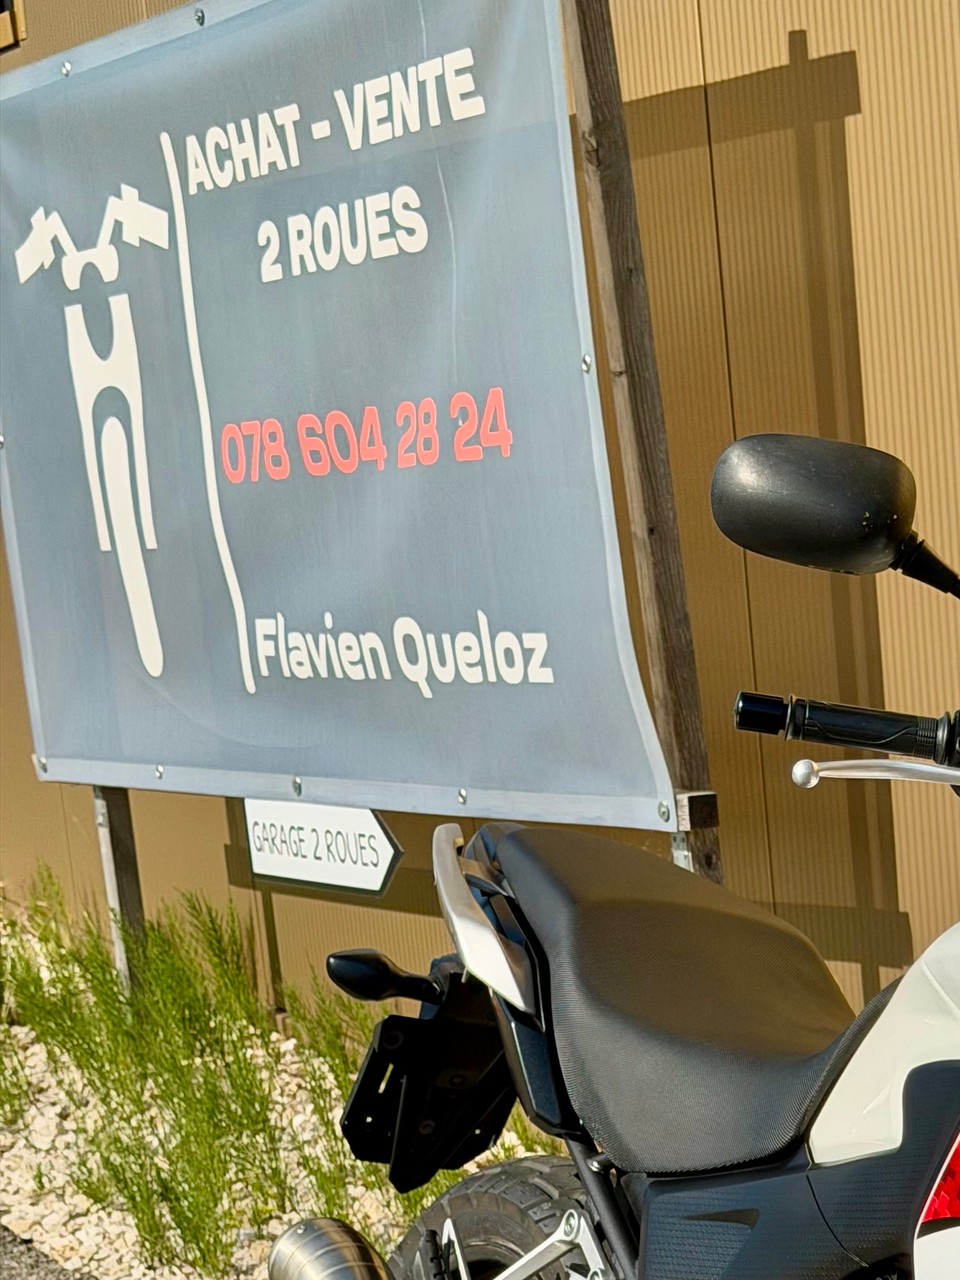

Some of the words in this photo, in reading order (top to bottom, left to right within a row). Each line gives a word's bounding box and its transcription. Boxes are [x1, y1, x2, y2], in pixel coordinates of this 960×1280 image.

[186, 103, 300, 195] ACHAT
[311, 119, 331, 140] -
[333, 47, 485, 150] VENTE
[257, 220, 283, 283] 2
[287, 185, 429, 277] ROUES
[221, 418, 290, 484] 078
[297, 406, 388, 477] 604
[396, 397, 440, 469] 28
[450, 386, 513, 462] 24
[255, 611, 392, 681] Flavien
[393, 609, 555, 699] Queloz
[252, 820, 308, 860] GARAGE
[310, 827, 323, 861] 2
[324, 829, 380, 868] ROUES
